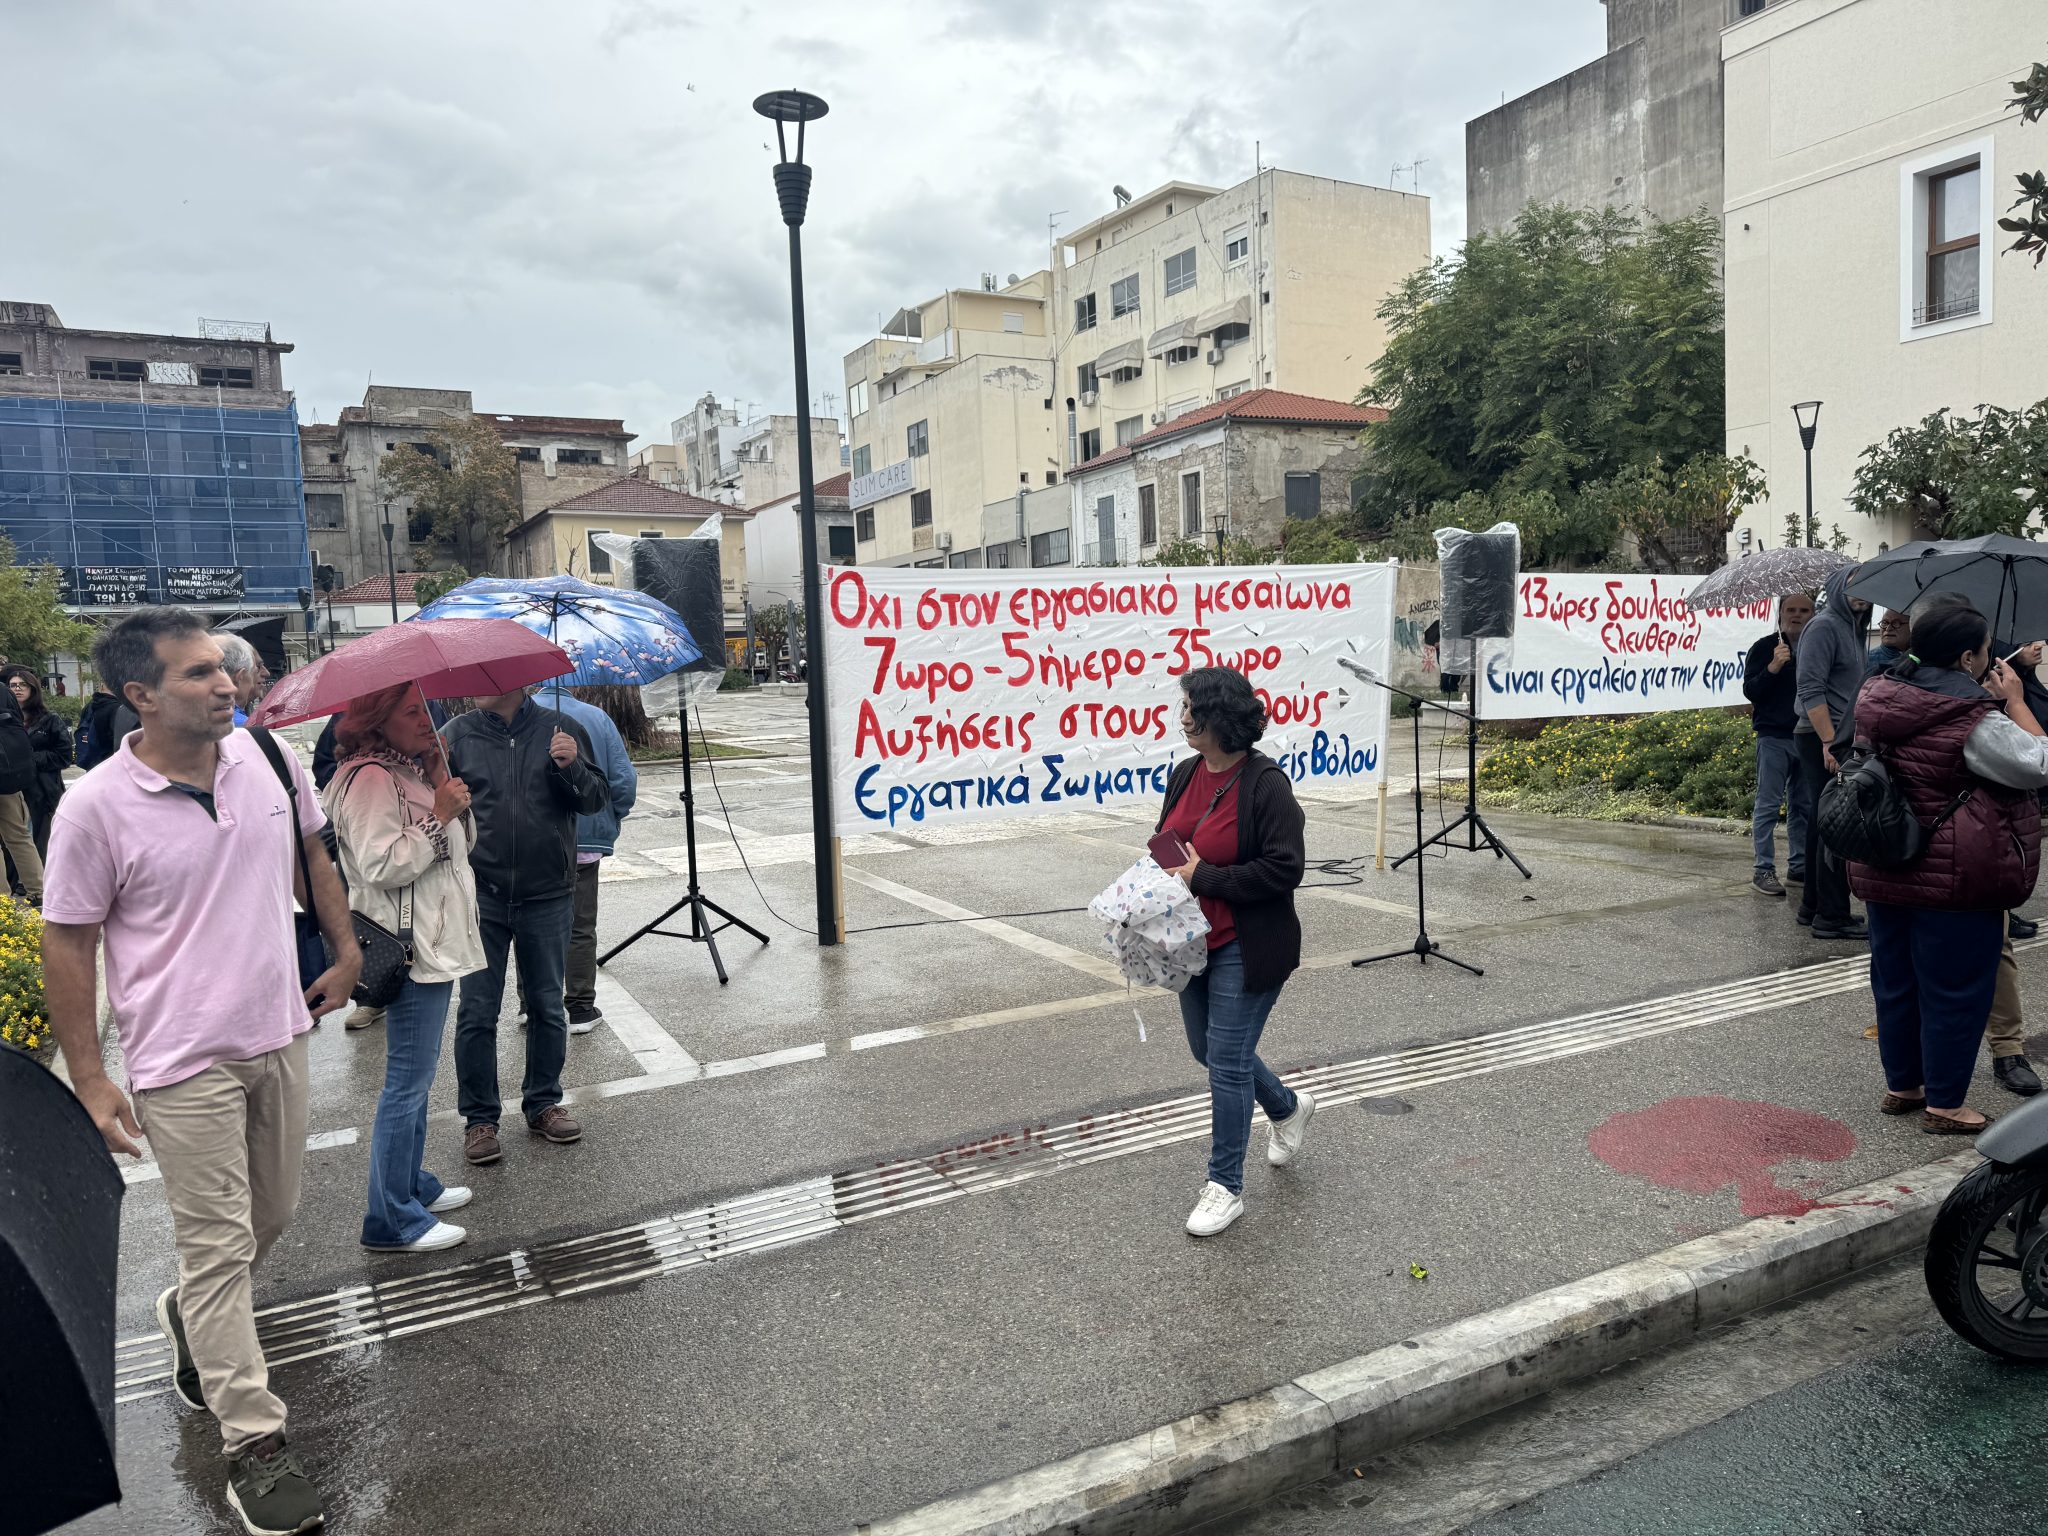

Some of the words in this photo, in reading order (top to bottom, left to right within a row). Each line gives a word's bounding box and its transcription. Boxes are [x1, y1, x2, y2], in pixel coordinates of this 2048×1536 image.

[0, 302, 46, 322] ΝΩΣΗ
[854, 476, 876, 498] SLIM
[878, 463, 907, 489] CARE
[88, 583, 120, 592] ΠΑΥΣΗ
[95, 593, 116, 603] ΤΩΝ
[916, 588, 1001, 632] στον
[1009, 573, 1179, 633] εργασιακό
[1194, 571, 1352, 629] μεσαίωνα
[1600, 621, 1703, 657] Ελευθερία!
[1550, 655, 1637, 704] εργαλείο
[1702, 650, 1747, 695] εργοδ
[855, 697, 1037, 765] Αυξήσεις
[1059, 702, 1169, 741] στους
[854, 762, 1030, 829] Εργατικά
[1040, 750, 1174, 807] Σωματεί
[1310, 728, 1378, 779] Βόλου
